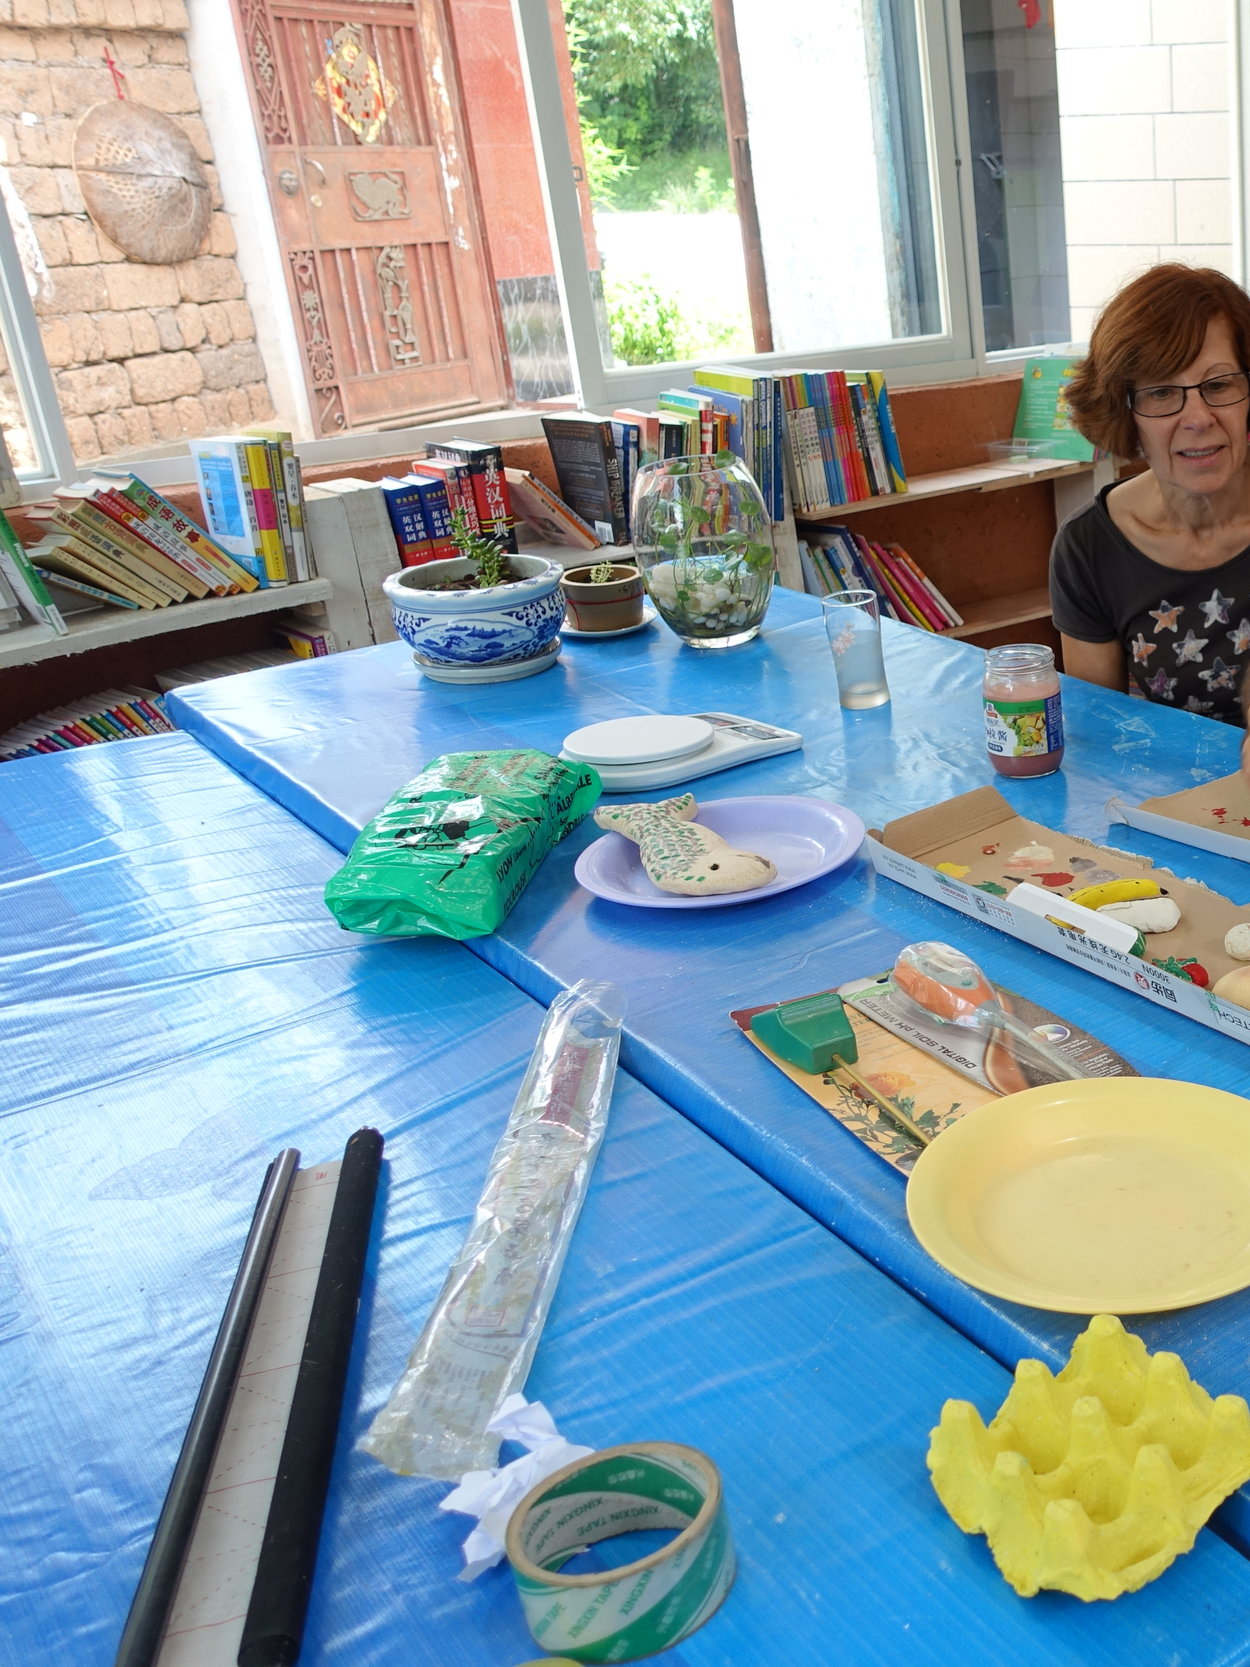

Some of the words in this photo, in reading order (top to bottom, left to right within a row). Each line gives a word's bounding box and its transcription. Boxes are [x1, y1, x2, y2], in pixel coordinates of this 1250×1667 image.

[607, 457, 620, 480] SHIP
[484, 466, 510, 540] 英汉词典
[609, 479, 626, 519] BREAKER
[146, 494, 201, 544] 成语故事
[496, 853, 513, 882] LYON
[860, 998, 898, 1024] METER
[896, 1021, 916, 1032] pH
[912, 1030, 940, 1048] SOIL
[937, 1045, 978, 1069] DIGITAL
[557, 1497, 604, 1529] XINGXIN
[610, 1504, 660, 1522] XINGXIN
[576, 1516, 609, 1537] TAPE
